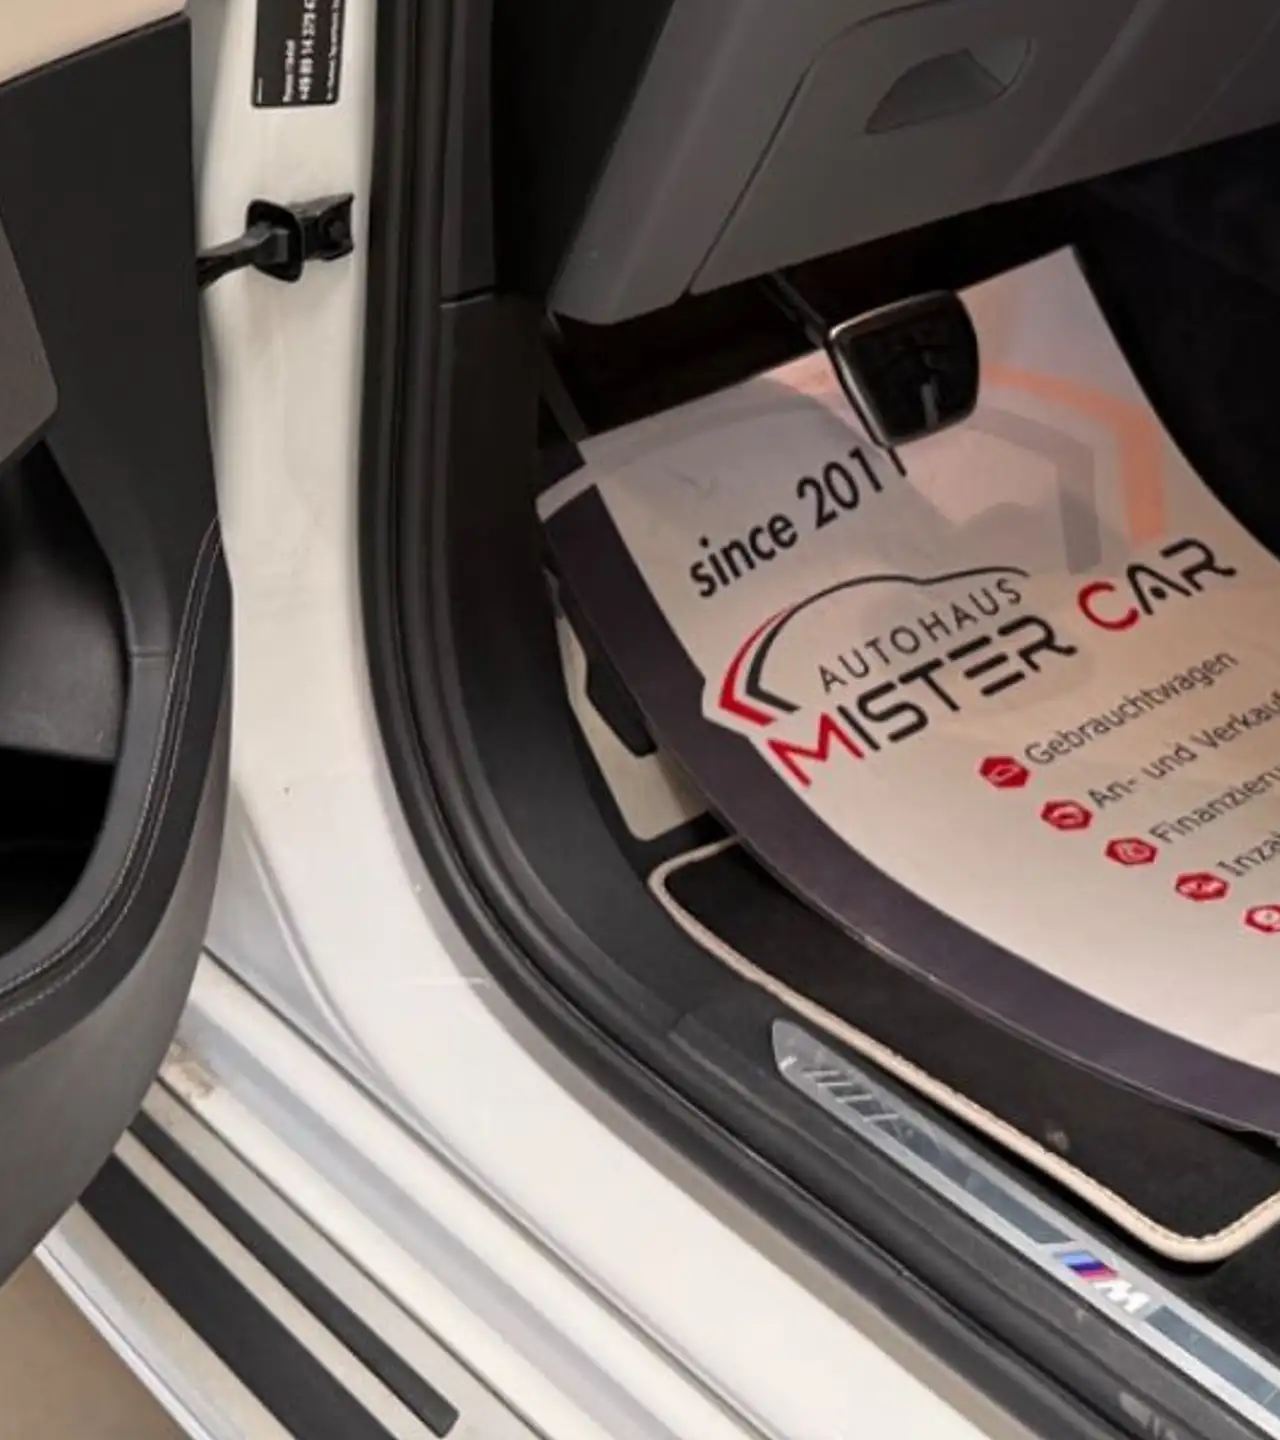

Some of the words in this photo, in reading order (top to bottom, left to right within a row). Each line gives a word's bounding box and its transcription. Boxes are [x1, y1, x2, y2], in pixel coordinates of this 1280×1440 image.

[689, 513, 798, 598] since
[767, 614, 1078, 788] MISTER
[1077, 537, 1237, 631] CAR
[818, 578, 1023, 692] AUTOHAUS
[1023, 651, 1240, 765] Gebrauchtwagen
[1087, 777, 1139, 810] An-
[1141, 740, 1199, 782] und
